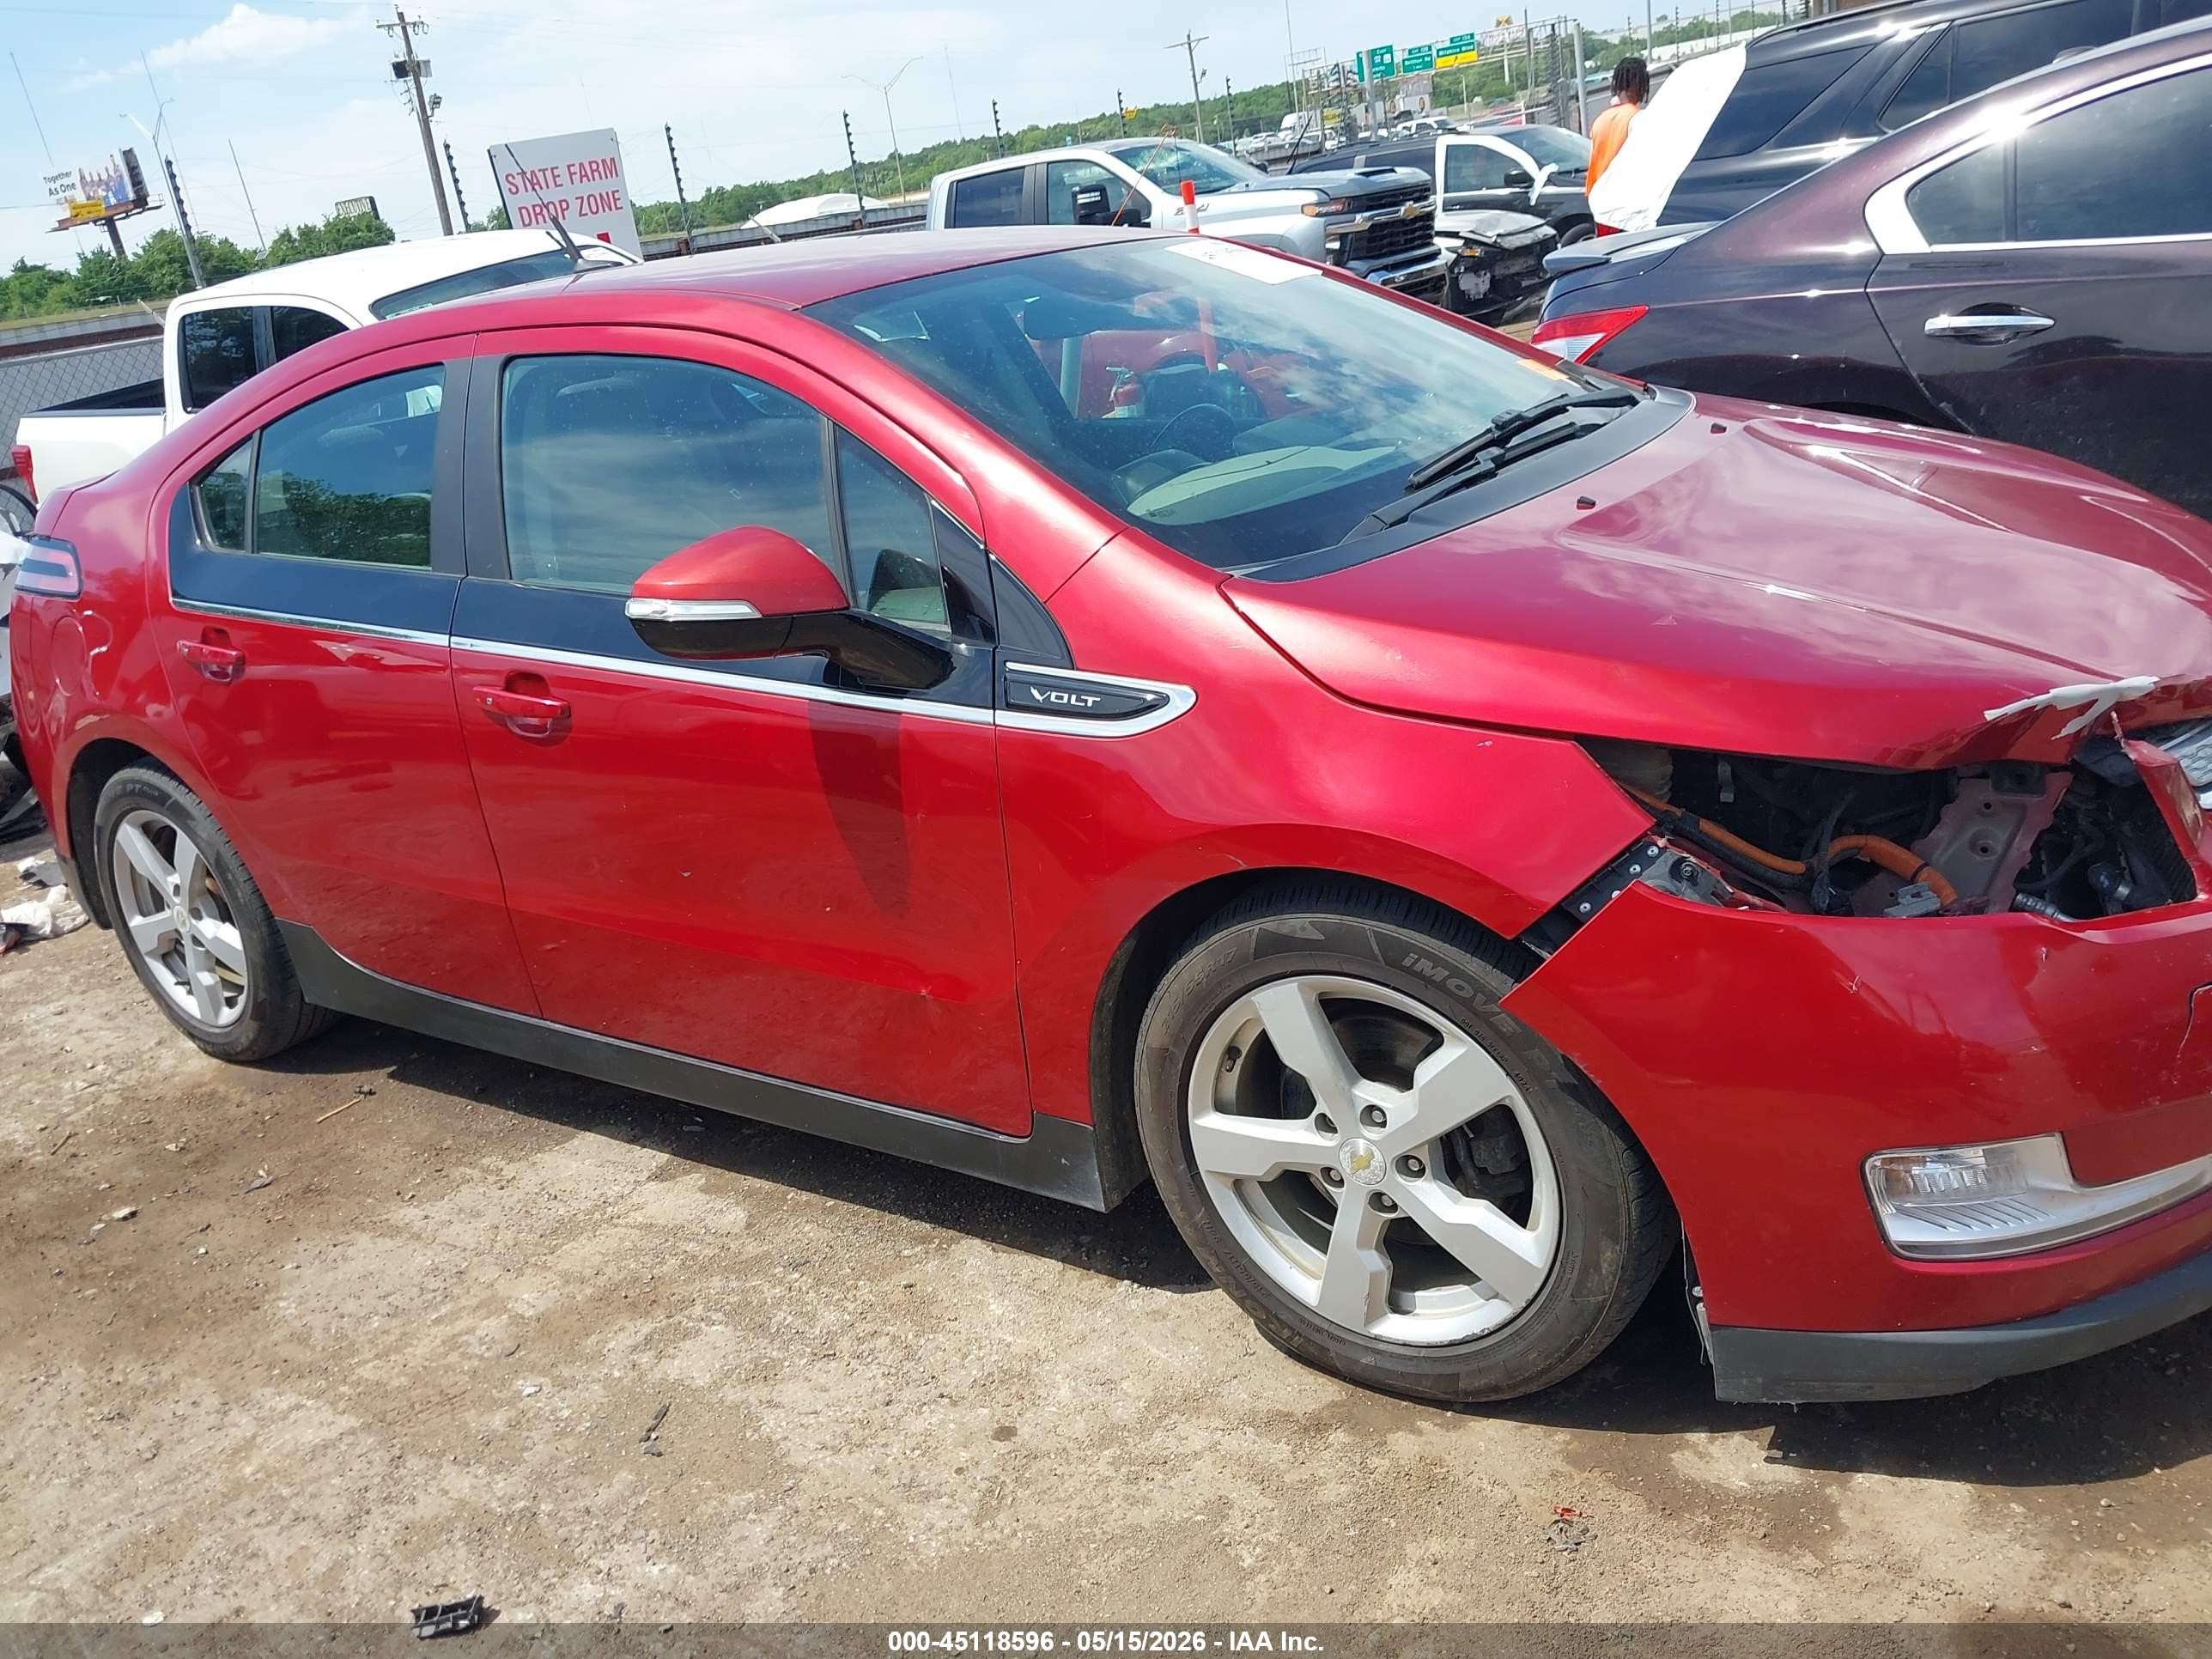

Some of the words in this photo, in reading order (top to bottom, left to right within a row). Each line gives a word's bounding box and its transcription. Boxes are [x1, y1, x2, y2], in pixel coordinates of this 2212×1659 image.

[43, 171, 72, 185] Together
[504, 166, 564, 196] STATE
[566, 157, 620, 185] FARM
[49, 187, 59, 198] As
[59, 182, 76, 193] One
[336, 198, 372, 215] EXECUTIVE
[517, 198, 570, 228] DROP
[574, 189, 624, 218] ZONE
[1030, 685, 1101, 708] VOLT
[1401, 952, 1522, 1038] iMOVE
